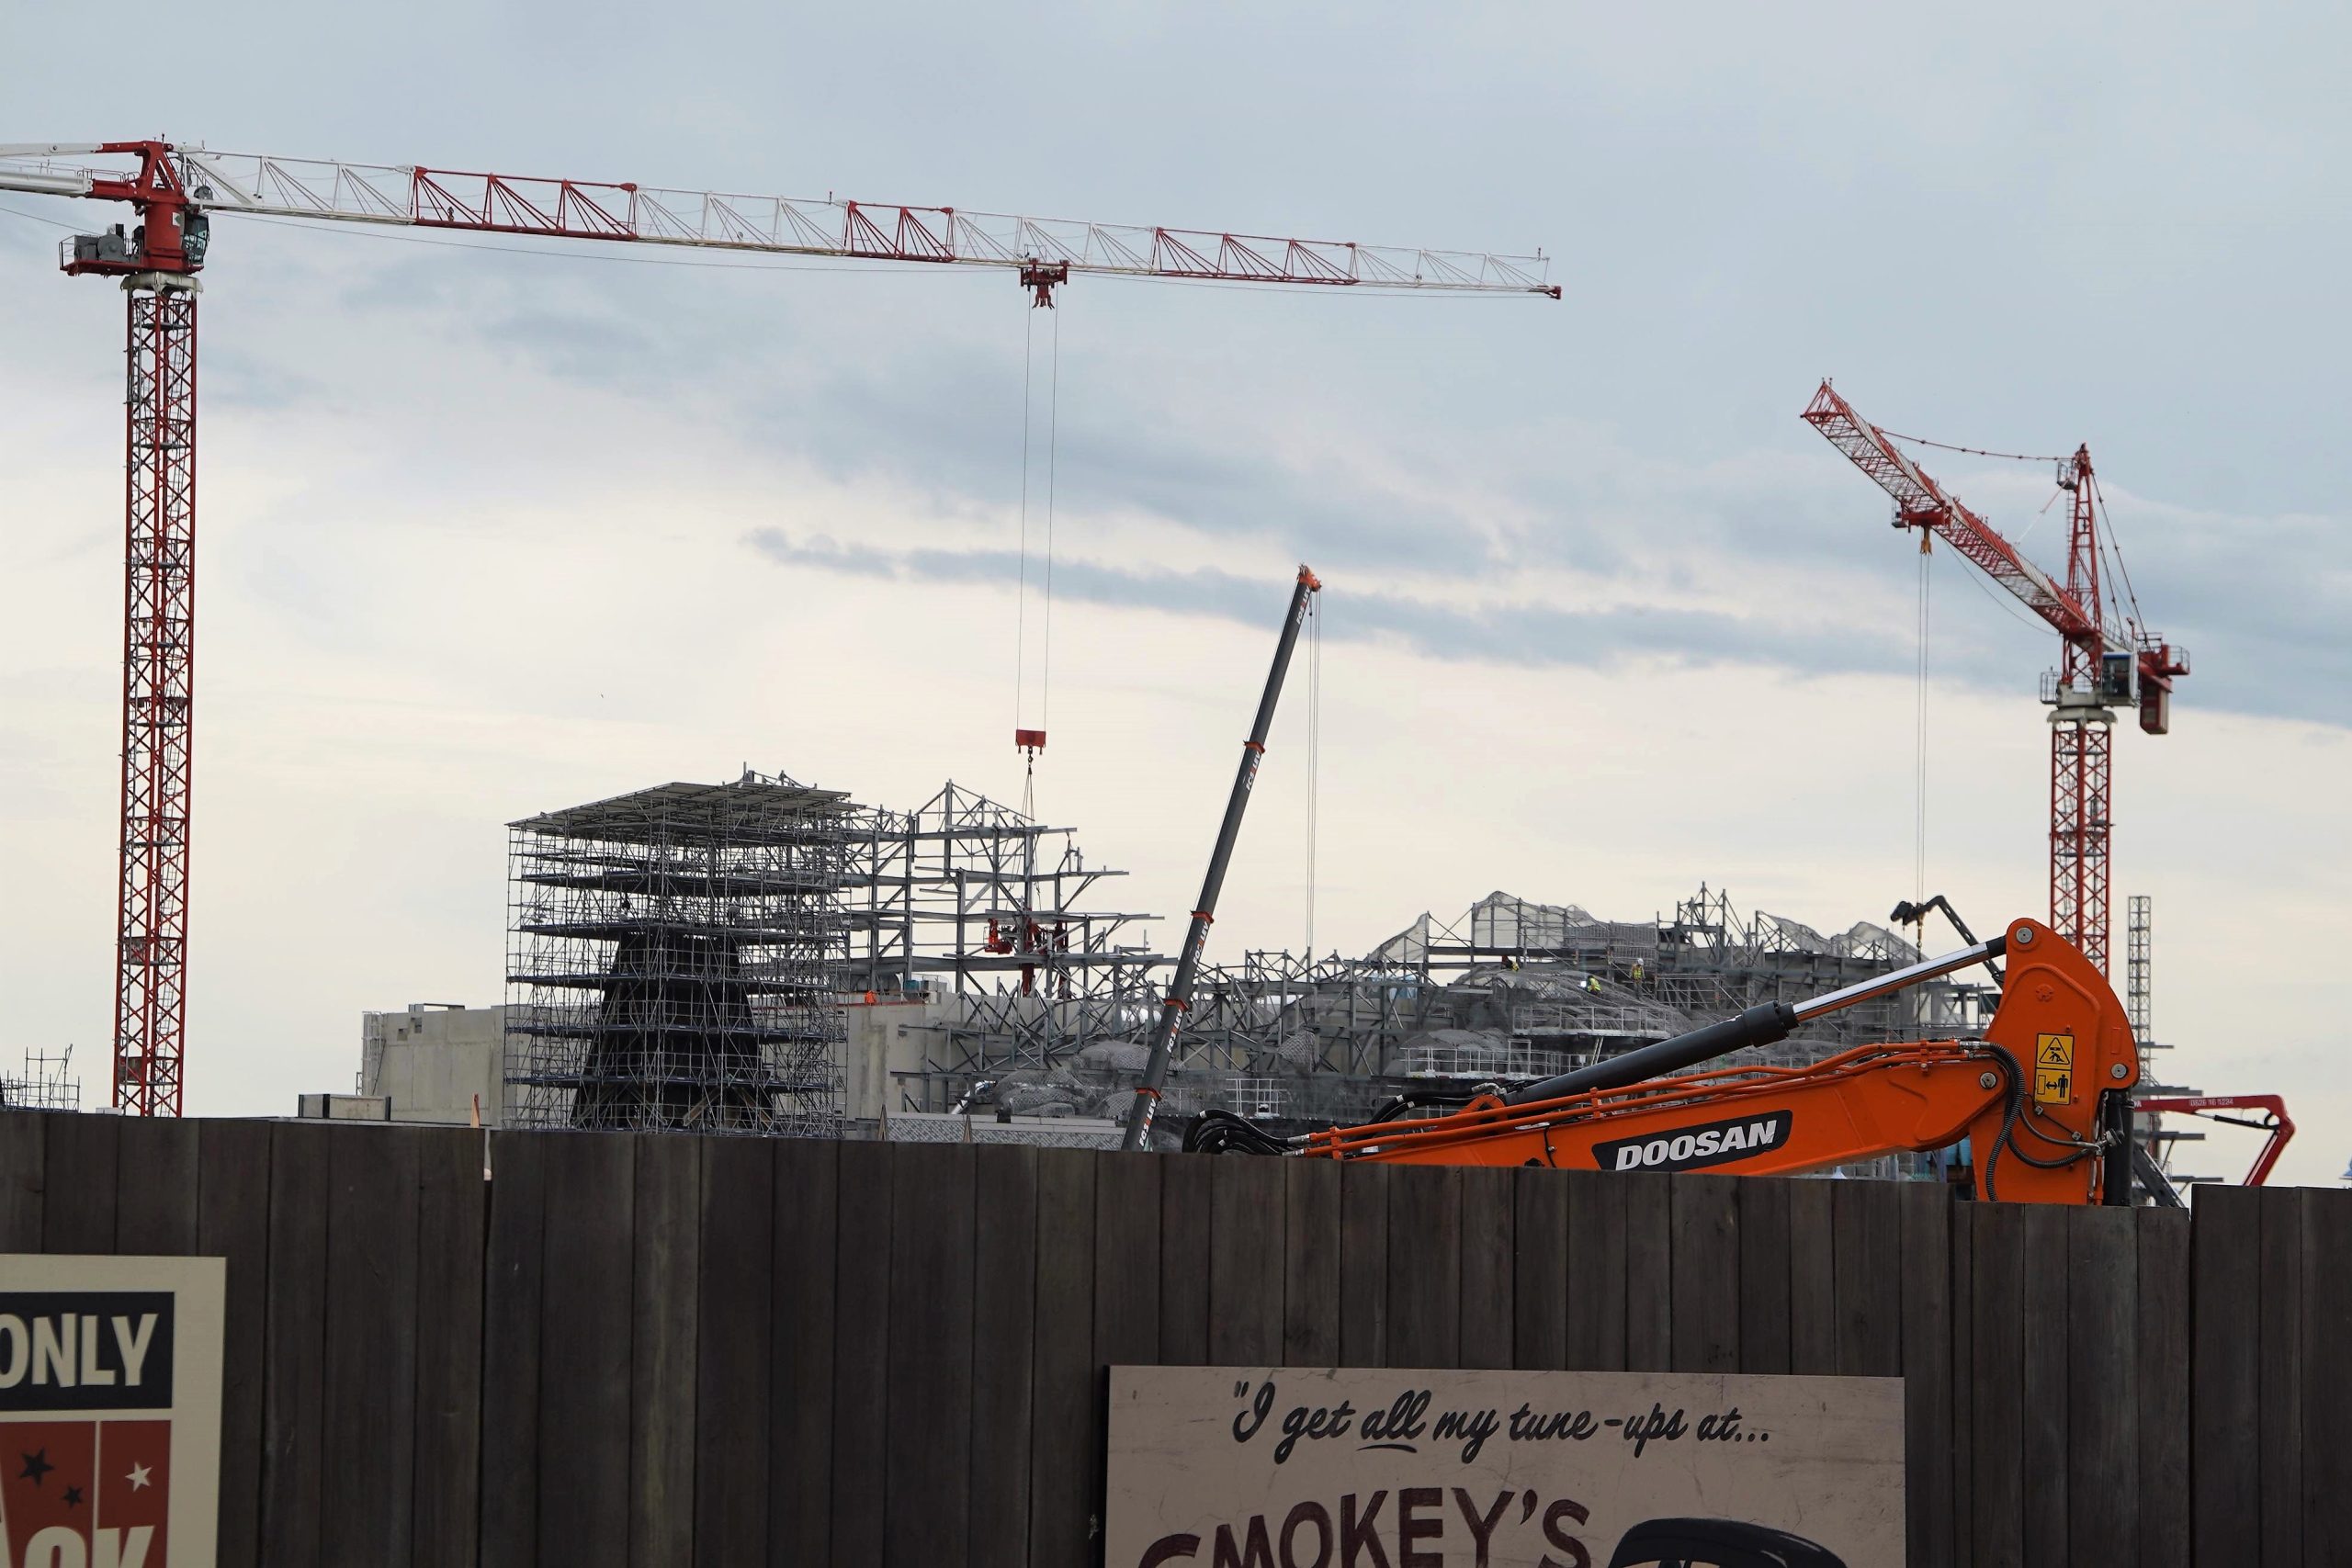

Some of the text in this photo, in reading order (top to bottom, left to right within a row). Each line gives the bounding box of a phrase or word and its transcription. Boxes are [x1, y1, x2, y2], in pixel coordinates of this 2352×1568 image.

[1615, 1120, 1777, 1171] DOOSAN
[0, 1313, 159, 1389] ONLY
[1274, 1400, 1356, 1464] get
[1361, 1390, 1432, 1440] all
[1432, 1409, 1500, 1464] my
[1697, 1407, 1770, 1442] at...
